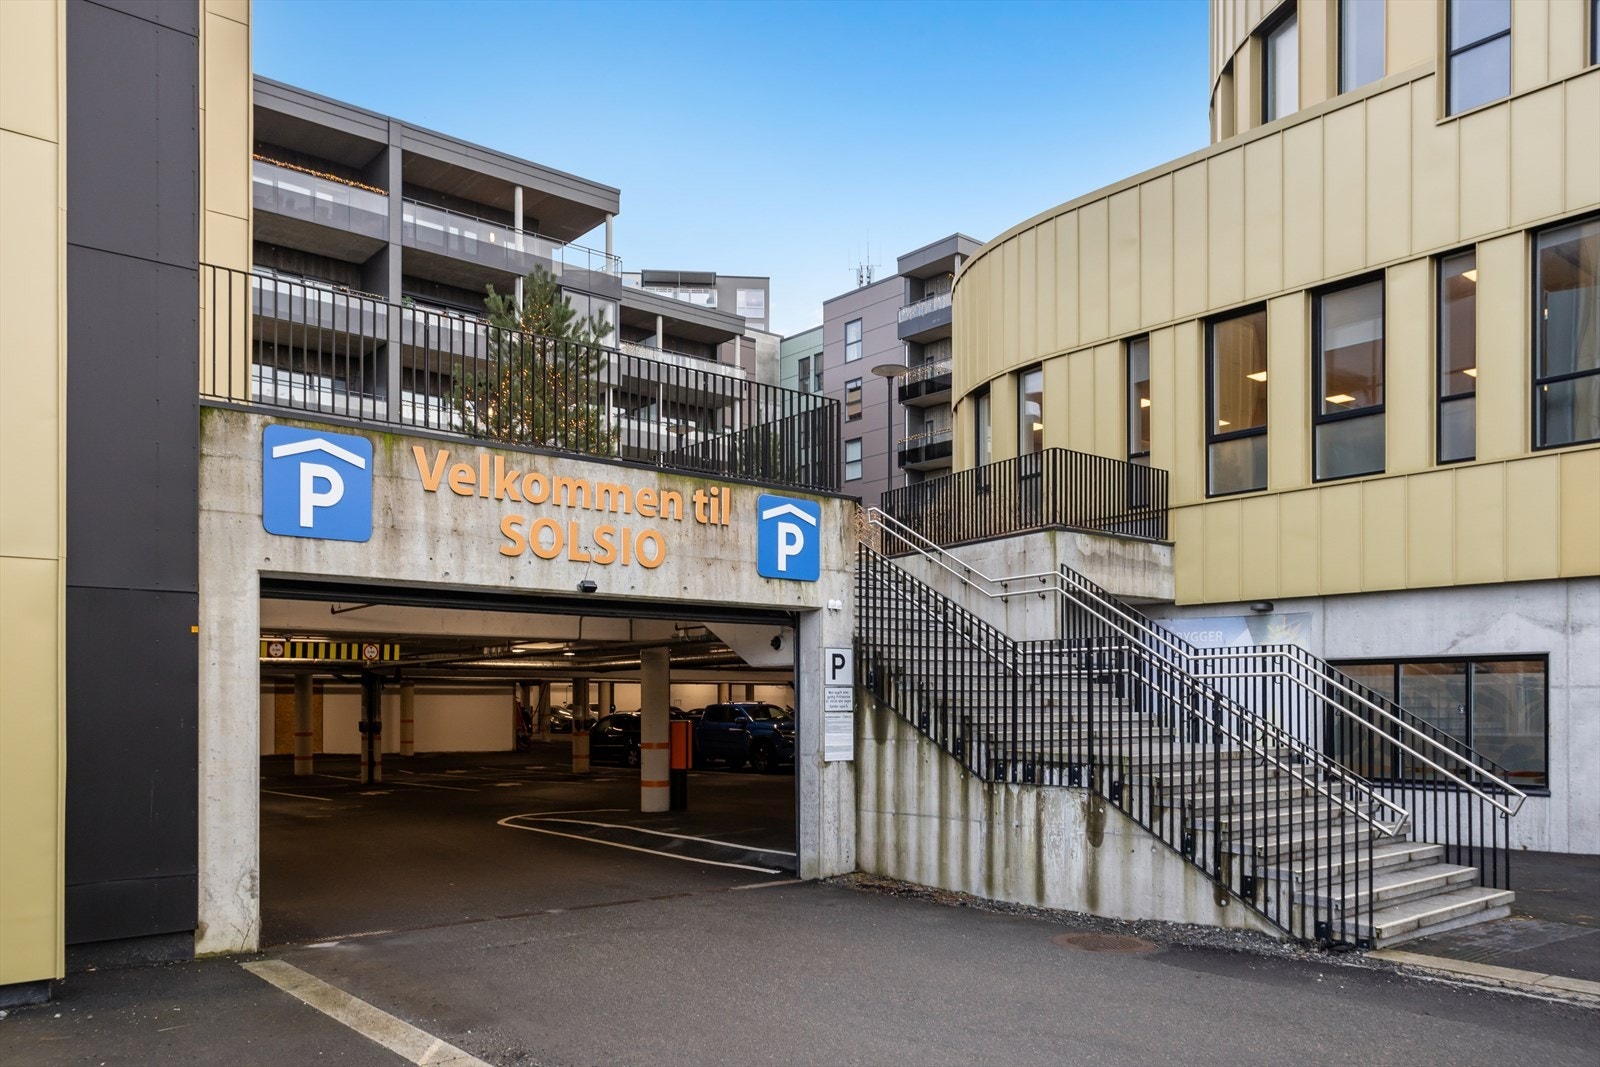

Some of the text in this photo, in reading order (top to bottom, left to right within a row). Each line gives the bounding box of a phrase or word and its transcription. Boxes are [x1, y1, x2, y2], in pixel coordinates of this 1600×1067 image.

[299, 461, 345, 528] P
[413, 445, 731, 525] Velkommen til
[501, 514, 667, 568] SOLSIO
[777, 521, 804, 572] P
[832, 653, 846, 680] P
